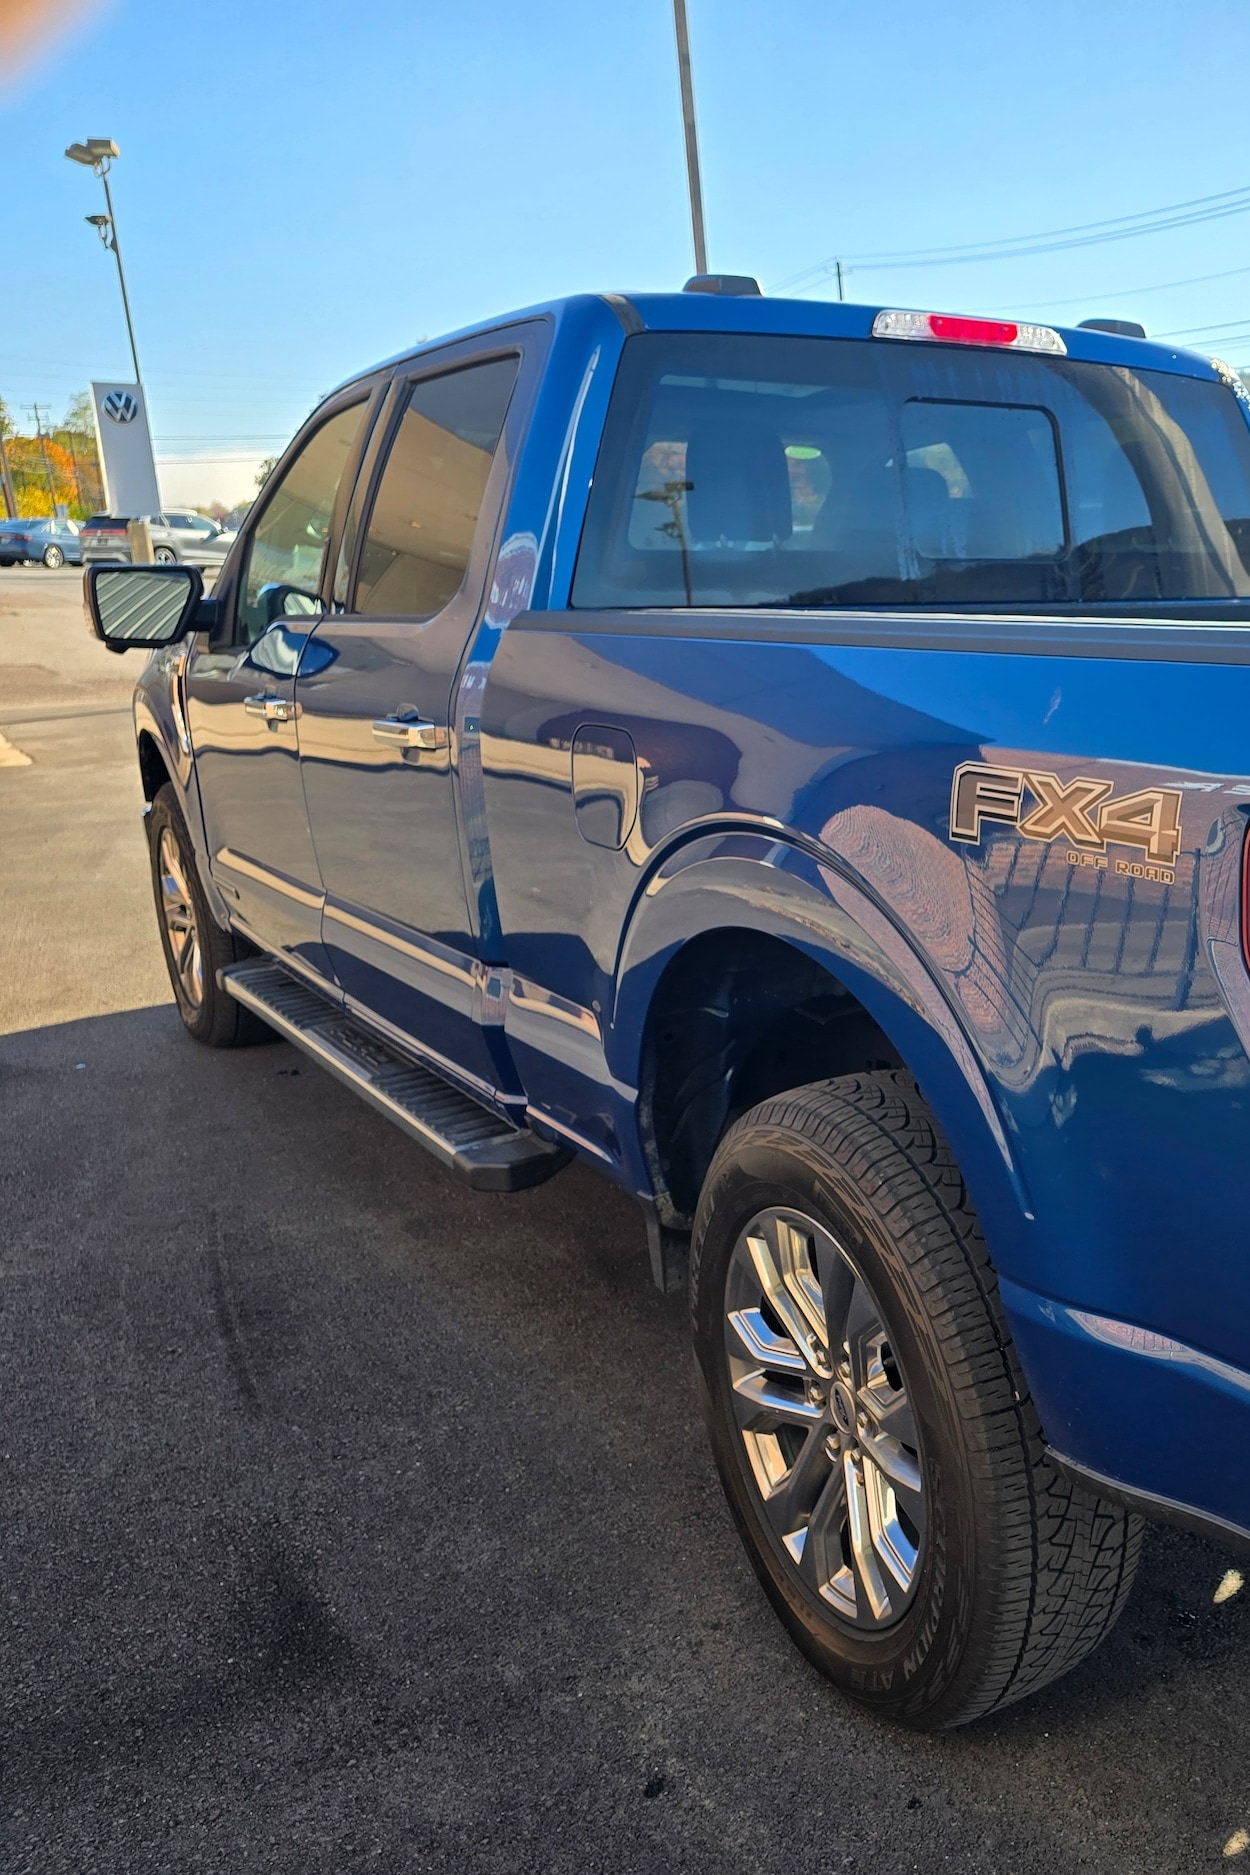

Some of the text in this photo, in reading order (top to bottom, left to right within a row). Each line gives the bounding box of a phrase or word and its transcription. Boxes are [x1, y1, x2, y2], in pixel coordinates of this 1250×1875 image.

[950, 760, 1183, 866] FX4
[1066, 850, 1176, 886] OFF ROAD
